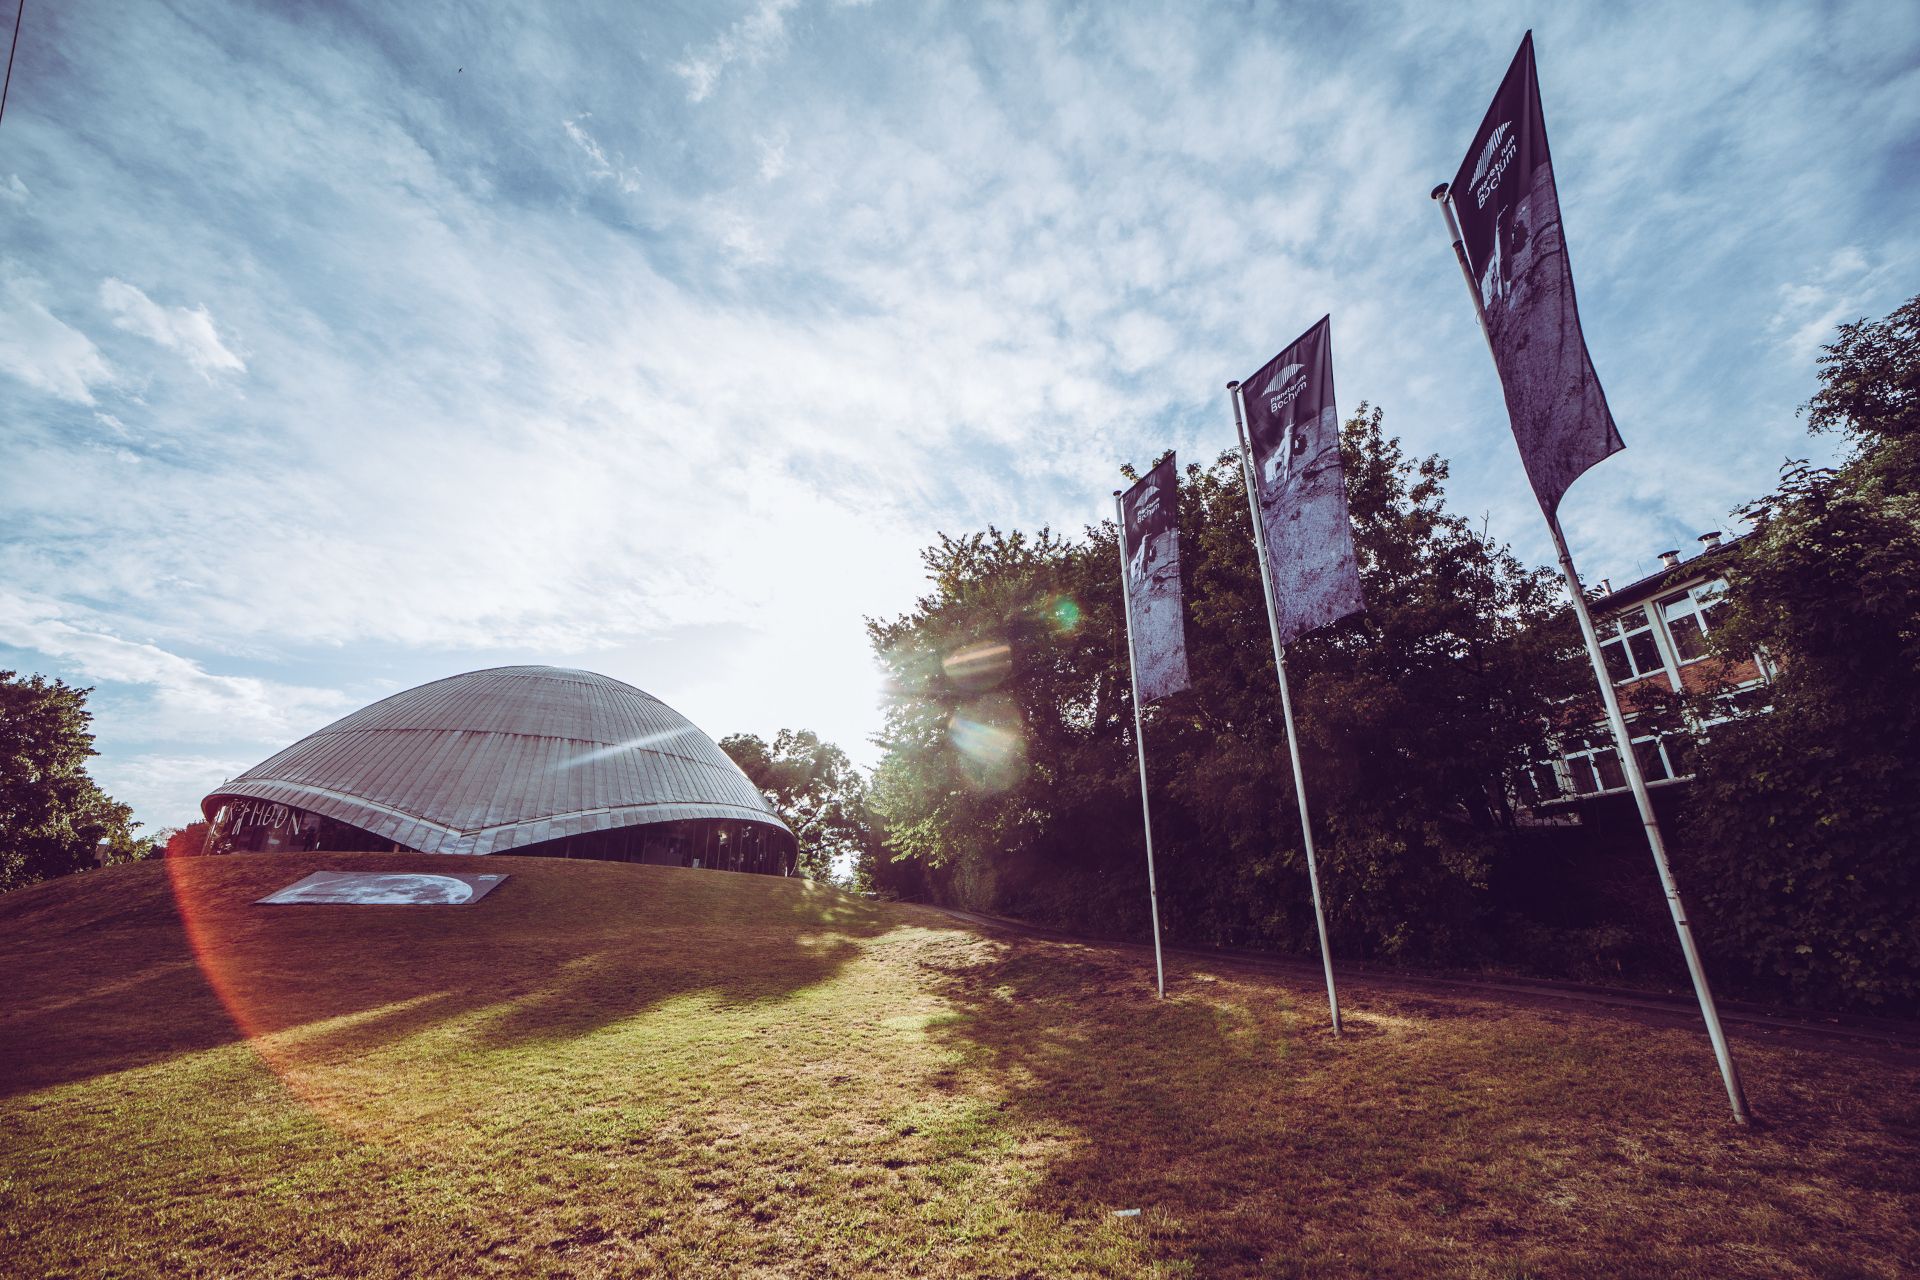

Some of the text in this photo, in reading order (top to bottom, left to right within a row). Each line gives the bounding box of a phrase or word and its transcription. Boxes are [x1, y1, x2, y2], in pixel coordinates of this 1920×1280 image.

[1477, 135, 1515, 198] Planetium
[1270, 374, 1306, 404] Plantarum
[1270, 382, 1307, 413] Bochum
